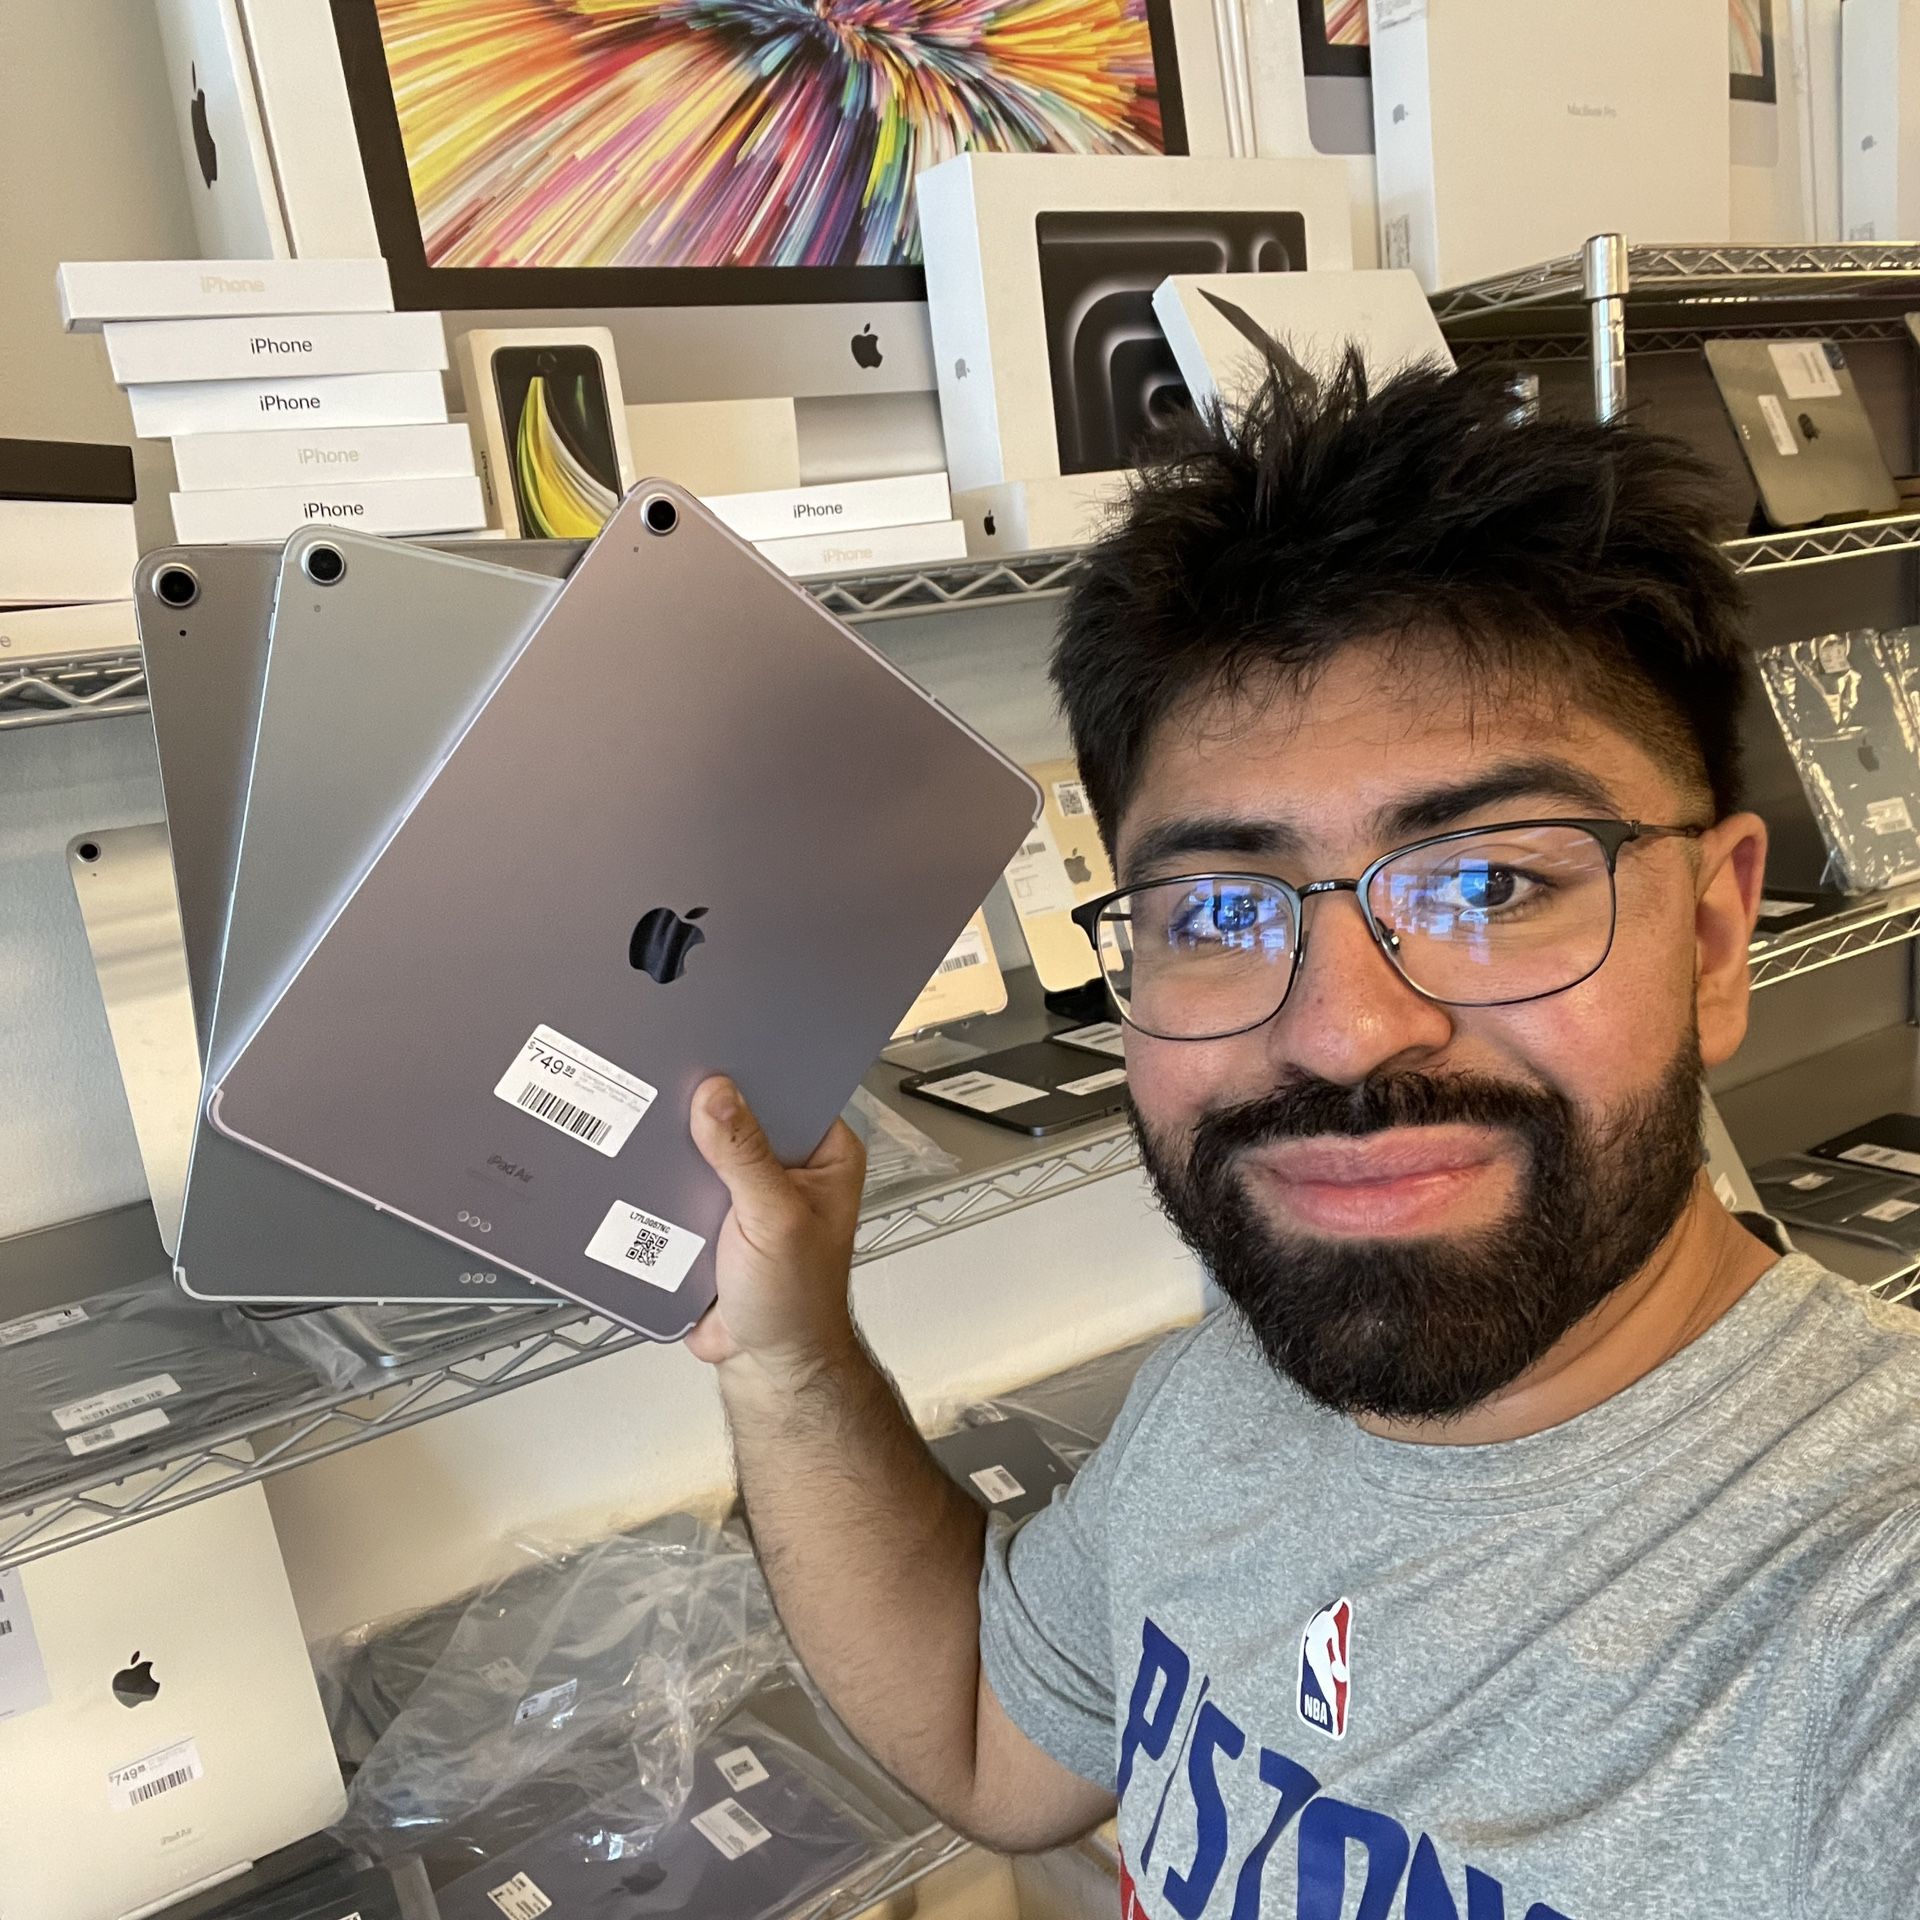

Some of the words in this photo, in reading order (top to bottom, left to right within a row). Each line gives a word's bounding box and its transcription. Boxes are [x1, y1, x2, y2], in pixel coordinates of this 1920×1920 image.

[200, 275, 266, 294] iPhone
[250, 337, 313, 355] iPhone
[259, 395, 321, 412] iPhone
[297, 447, 361, 465] iPhone
[303, 502, 364, 519] iPhone
[793, 504, 843, 518] iPhone
[824, 548, 872, 562] iPhone
[487, 1154, 517, 1175] iPad
[1304, 1693, 1328, 1726] NBA
